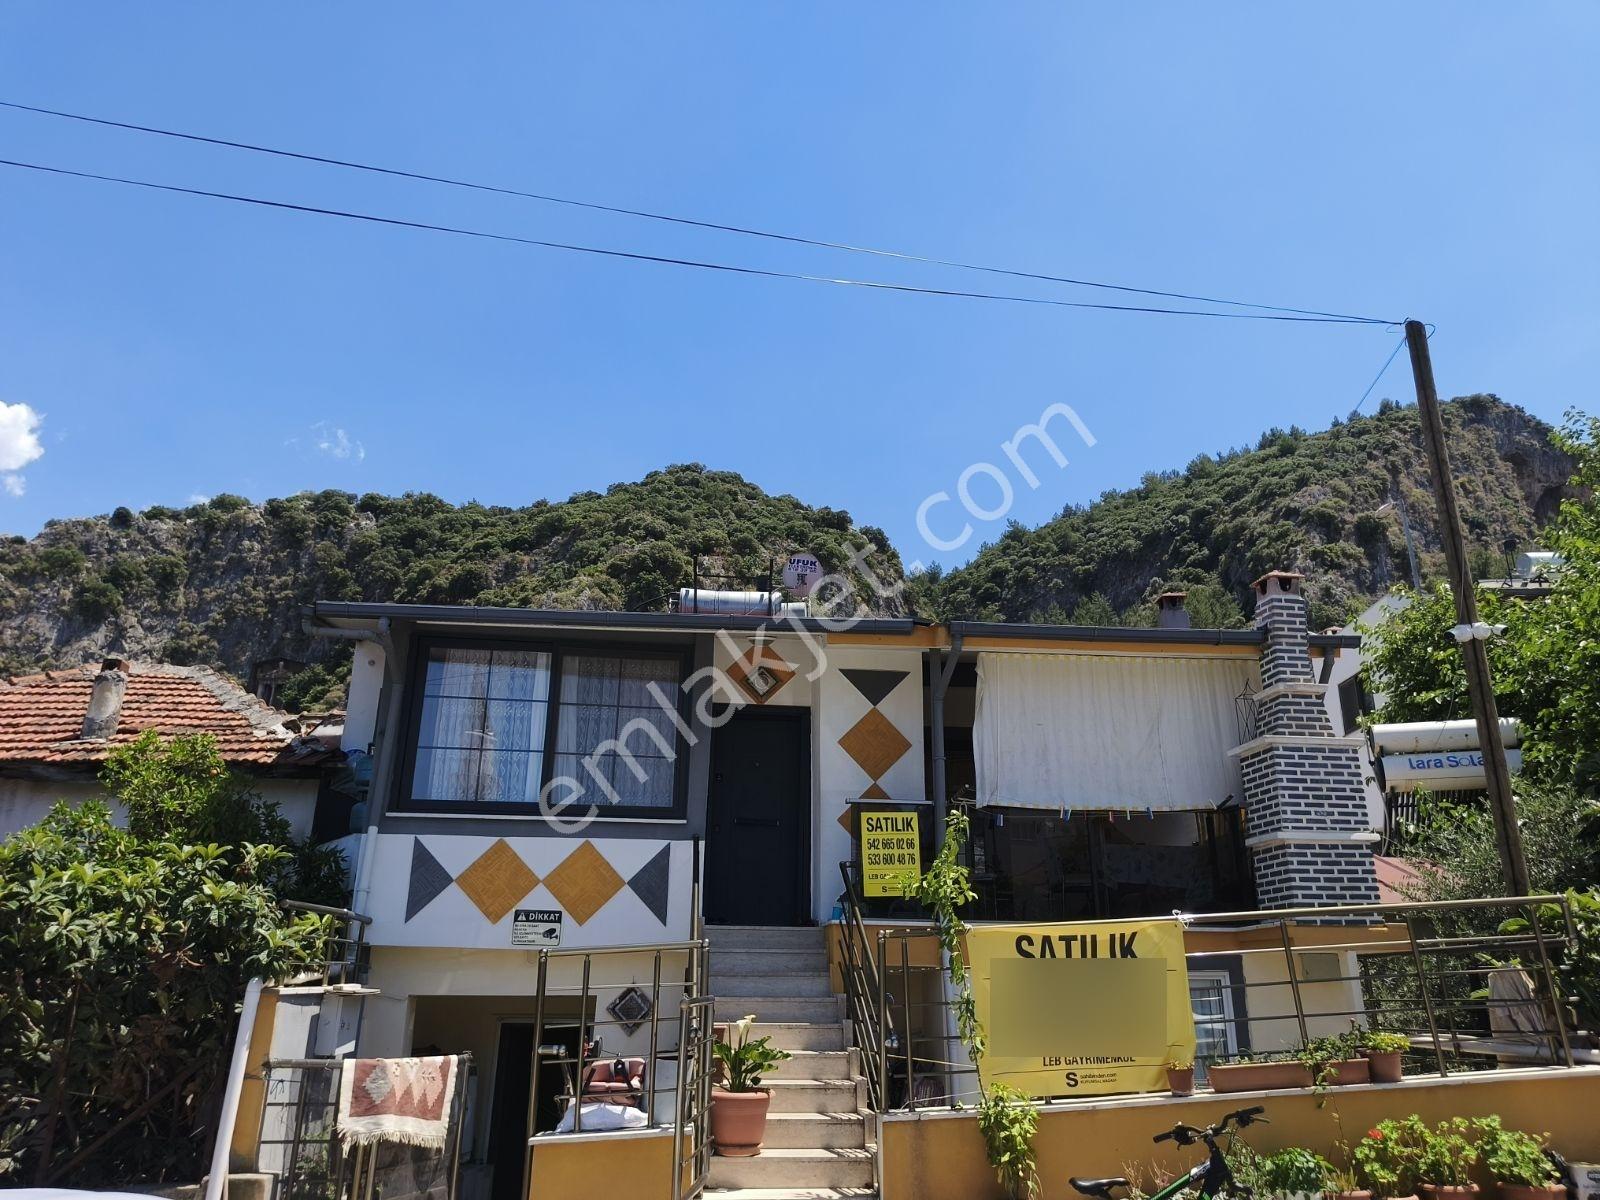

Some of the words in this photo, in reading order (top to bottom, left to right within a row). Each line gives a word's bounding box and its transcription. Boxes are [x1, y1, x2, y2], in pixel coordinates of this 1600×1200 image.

[789, 558, 817, 567] UFUK
[1446, 755, 1485, 768] Sola
[866, 816, 914, 832] SATILIK
[867, 837, 880, 850] 542
[896, 838, 904, 850] 02
[868, 853, 880, 866] 533
[882, 853, 895, 866] 600
[897, 853, 906, 865] 48
[907, 853, 916, 865] 76
[529, 912, 560, 921] DİKKAT
